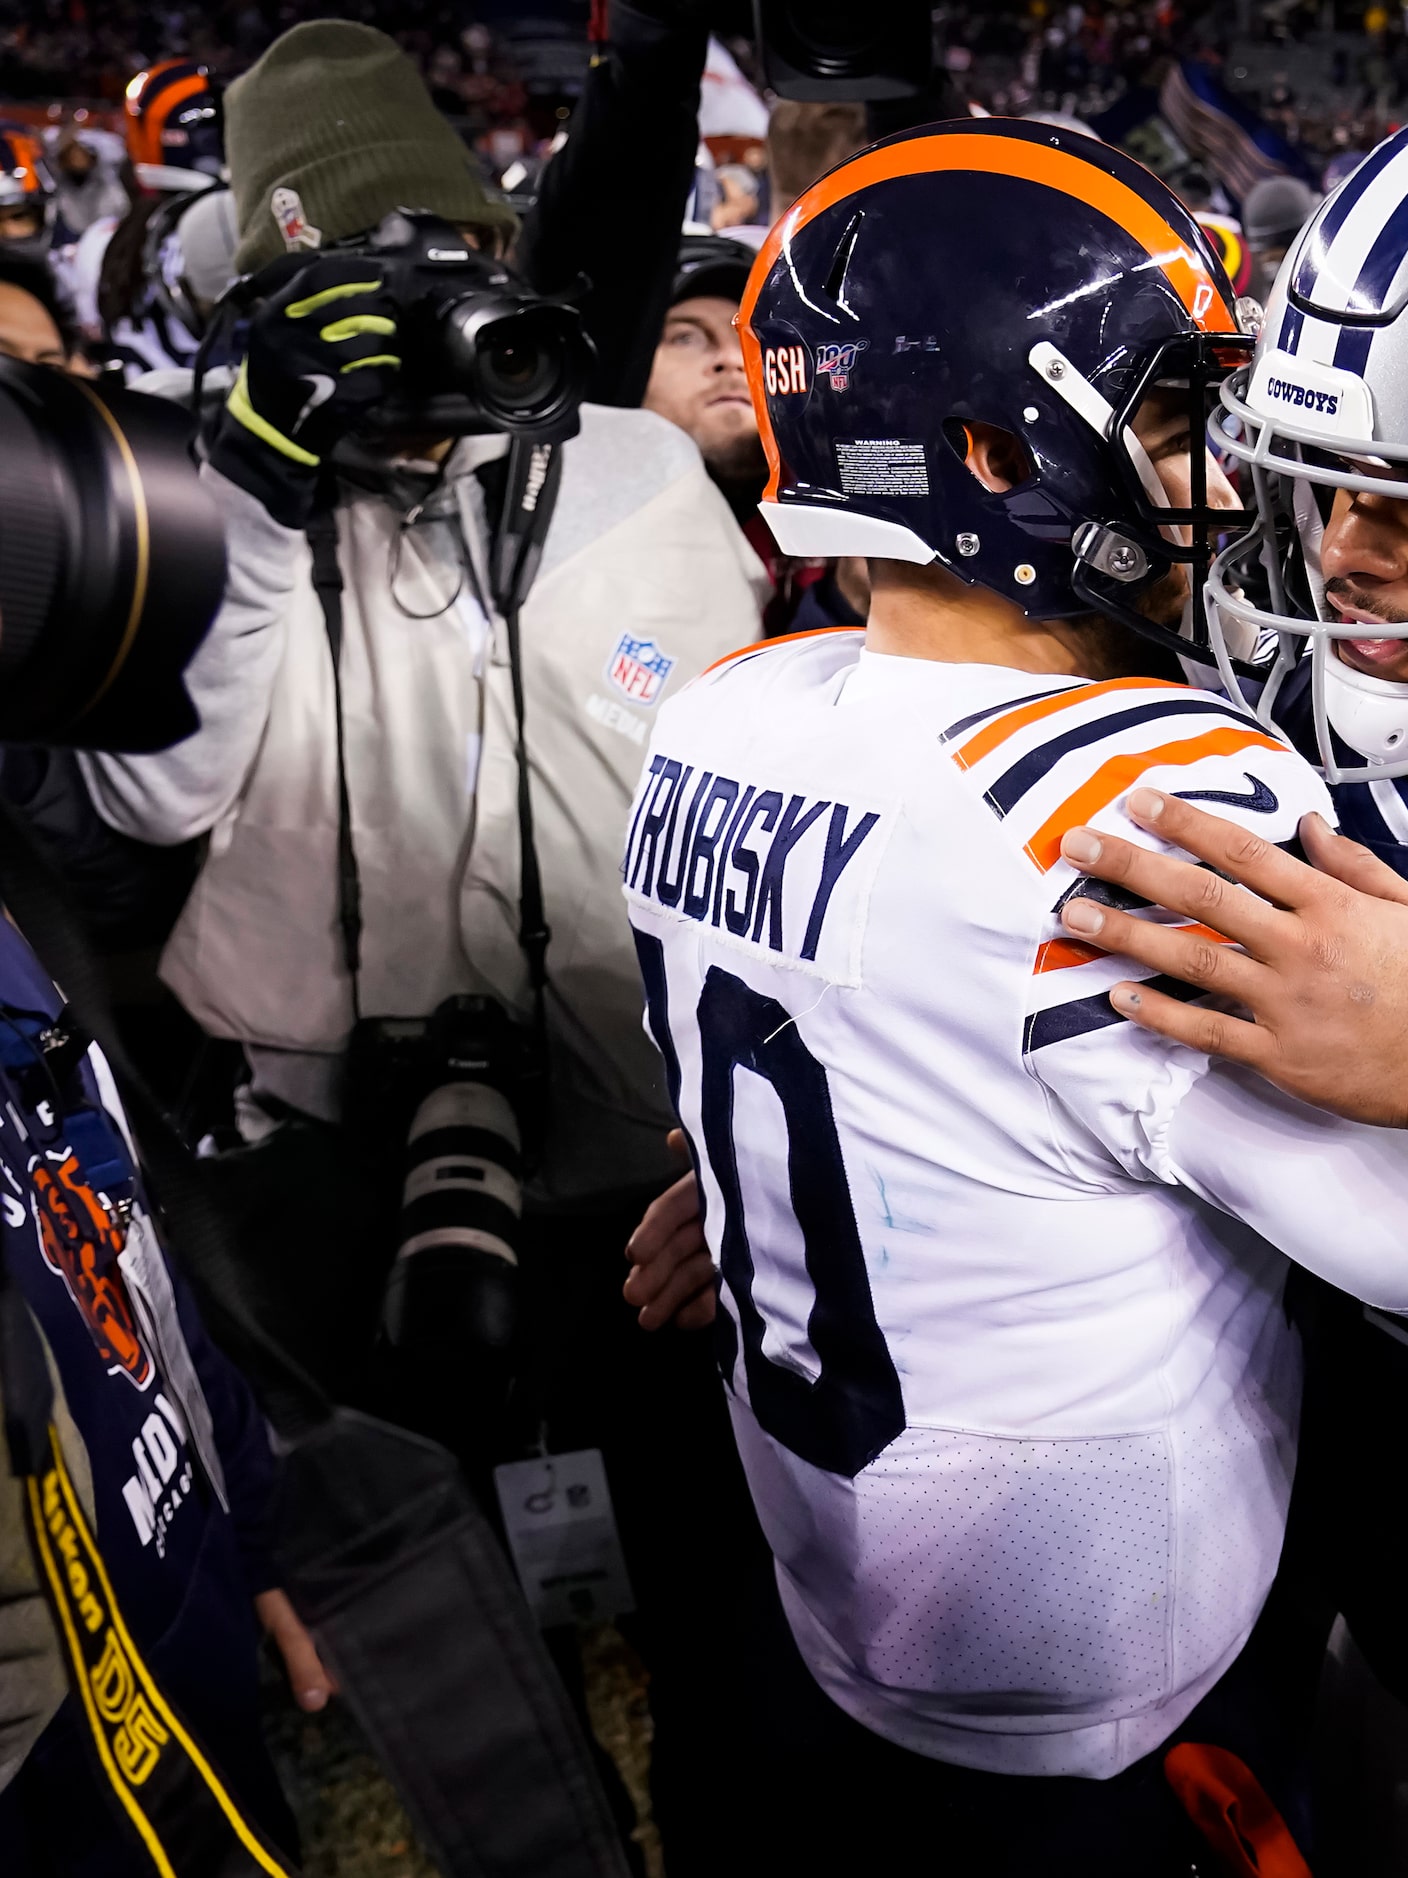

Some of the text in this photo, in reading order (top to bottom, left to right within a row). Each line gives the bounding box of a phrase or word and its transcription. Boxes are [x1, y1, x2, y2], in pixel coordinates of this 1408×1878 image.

[427, 248, 469, 261] Canon
[765, 345, 807, 396] GSH
[1267, 377, 1338, 415] COWBOYS
[612, 656, 654, 699] NFL
[624, 754, 881, 961] TRUBISKY
[42, 1467, 104, 1633] Nikon
[91, 1626, 170, 1776] D5
